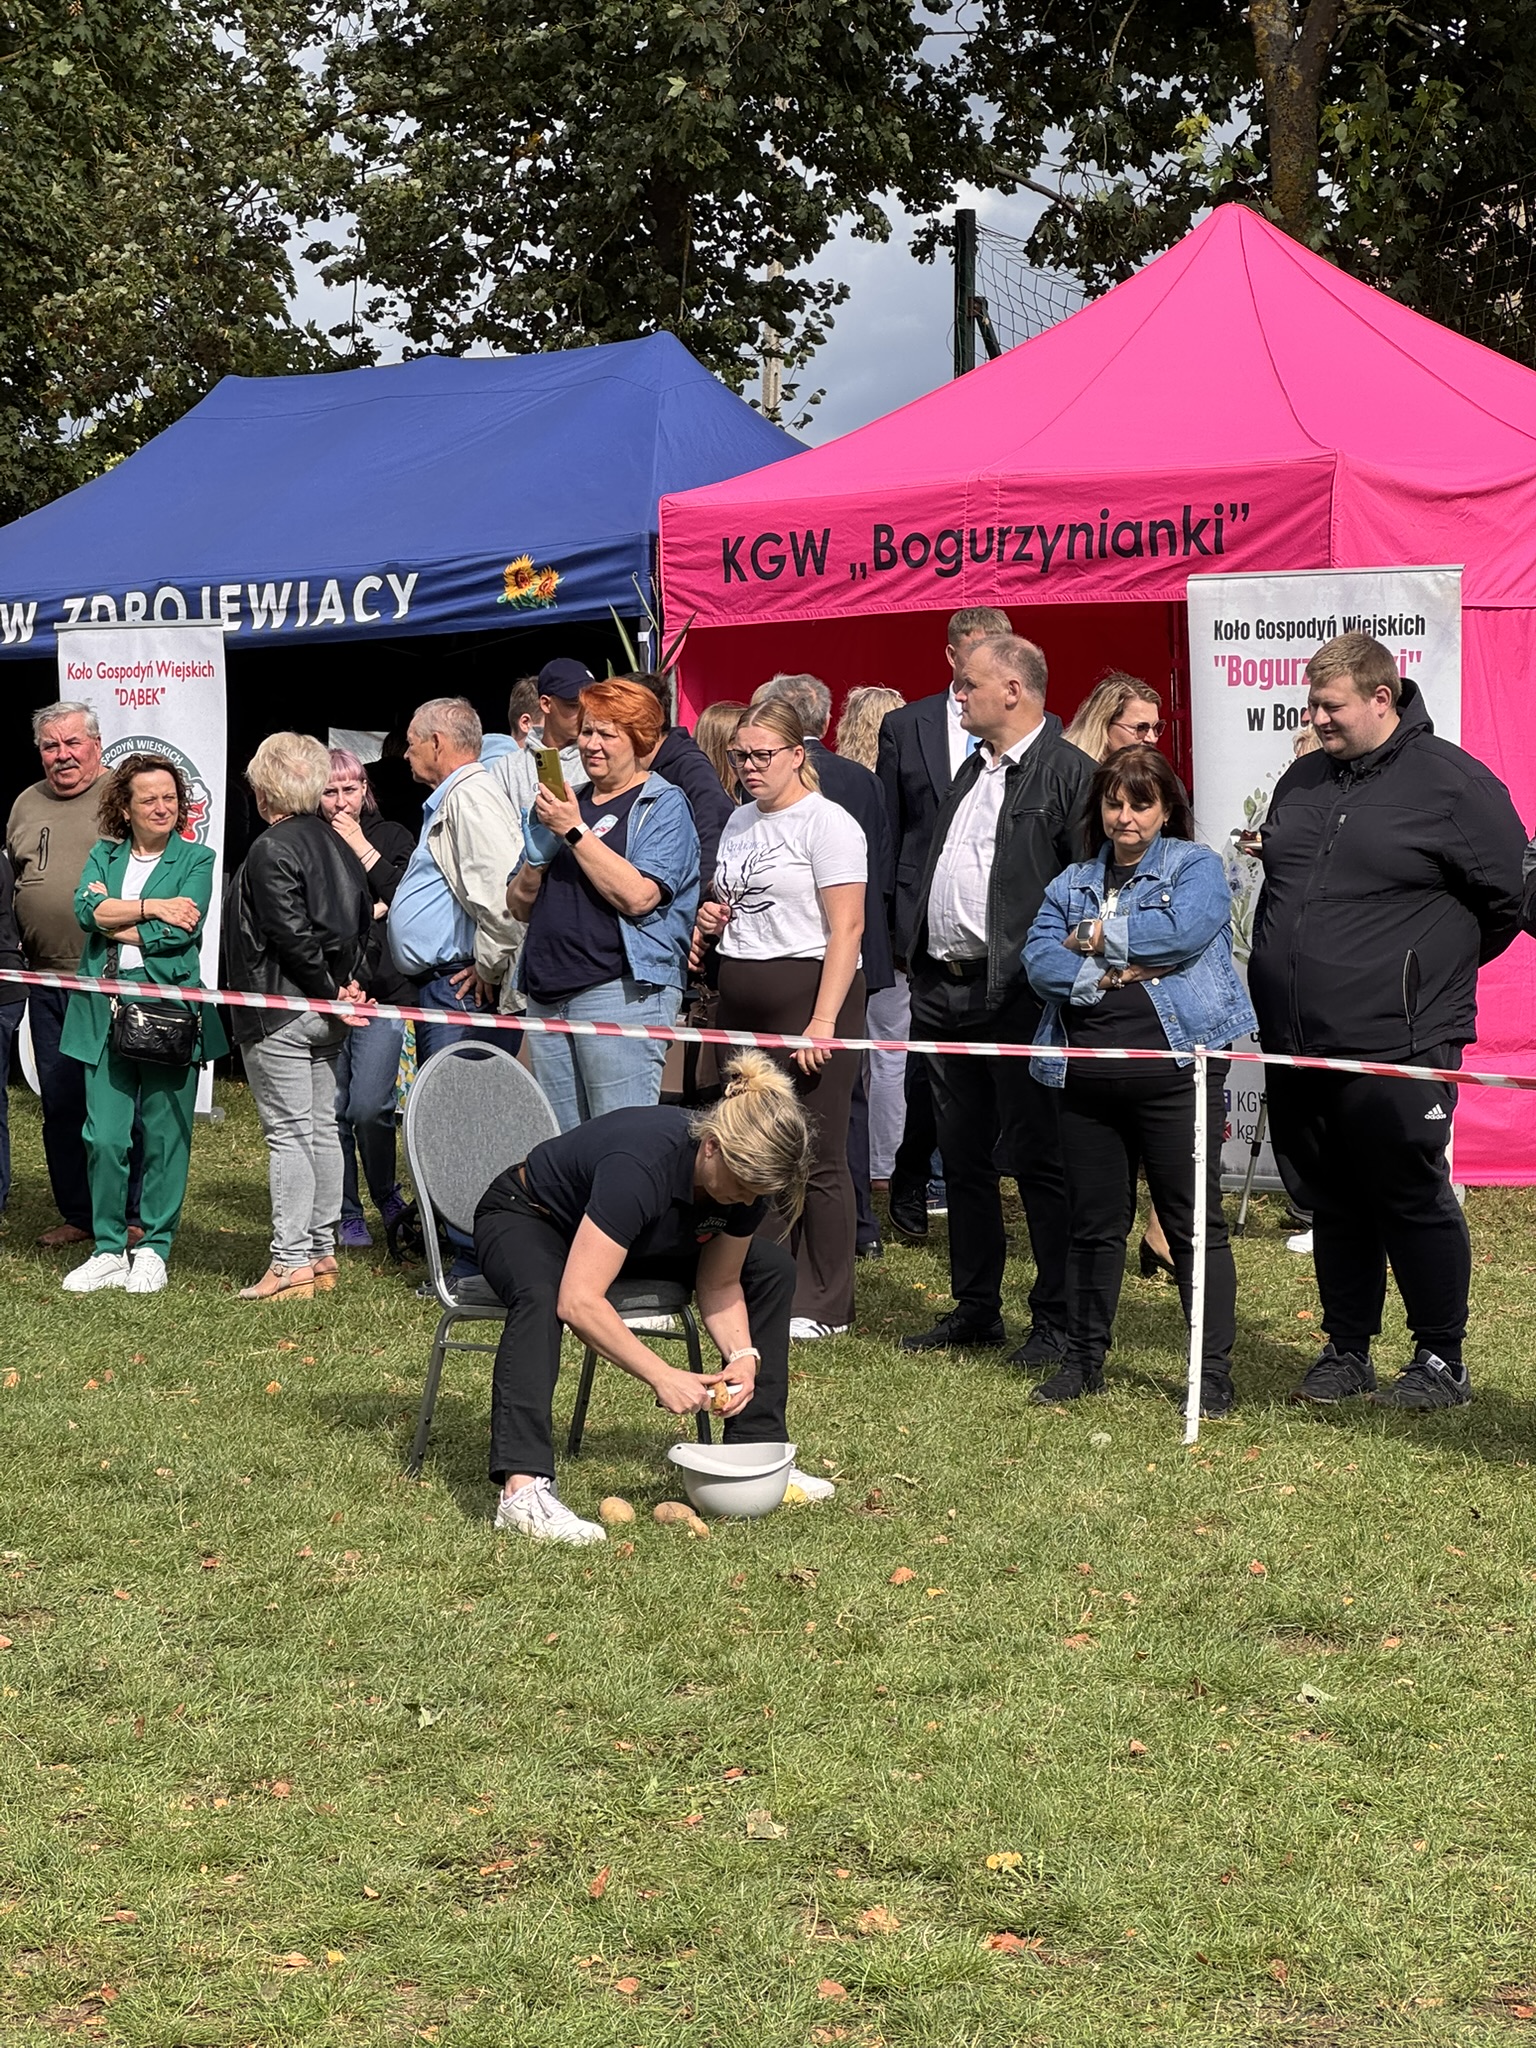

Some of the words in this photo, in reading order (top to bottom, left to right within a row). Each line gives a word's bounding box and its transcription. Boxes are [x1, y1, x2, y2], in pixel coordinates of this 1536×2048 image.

[721, 528, 831, 584] KGW
[0, 601, 38, 645] W
[1213, 618, 1251, 641] Koło
[1255, 614, 1337, 642] Gospodyń
[1342, 612, 1426, 640] Wiejskich
[67, 661, 93, 681] Koło
[96, 660, 154, 683] Gospodyń
[156, 659, 215, 682] Wiejskich
[115, 687, 166, 709] "DĄBEK"
[1246, 707, 1266, 732] w
[101, 738, 135, 766] SPODYŃ
[136, 739, 184, 765] WIEJSKICH
